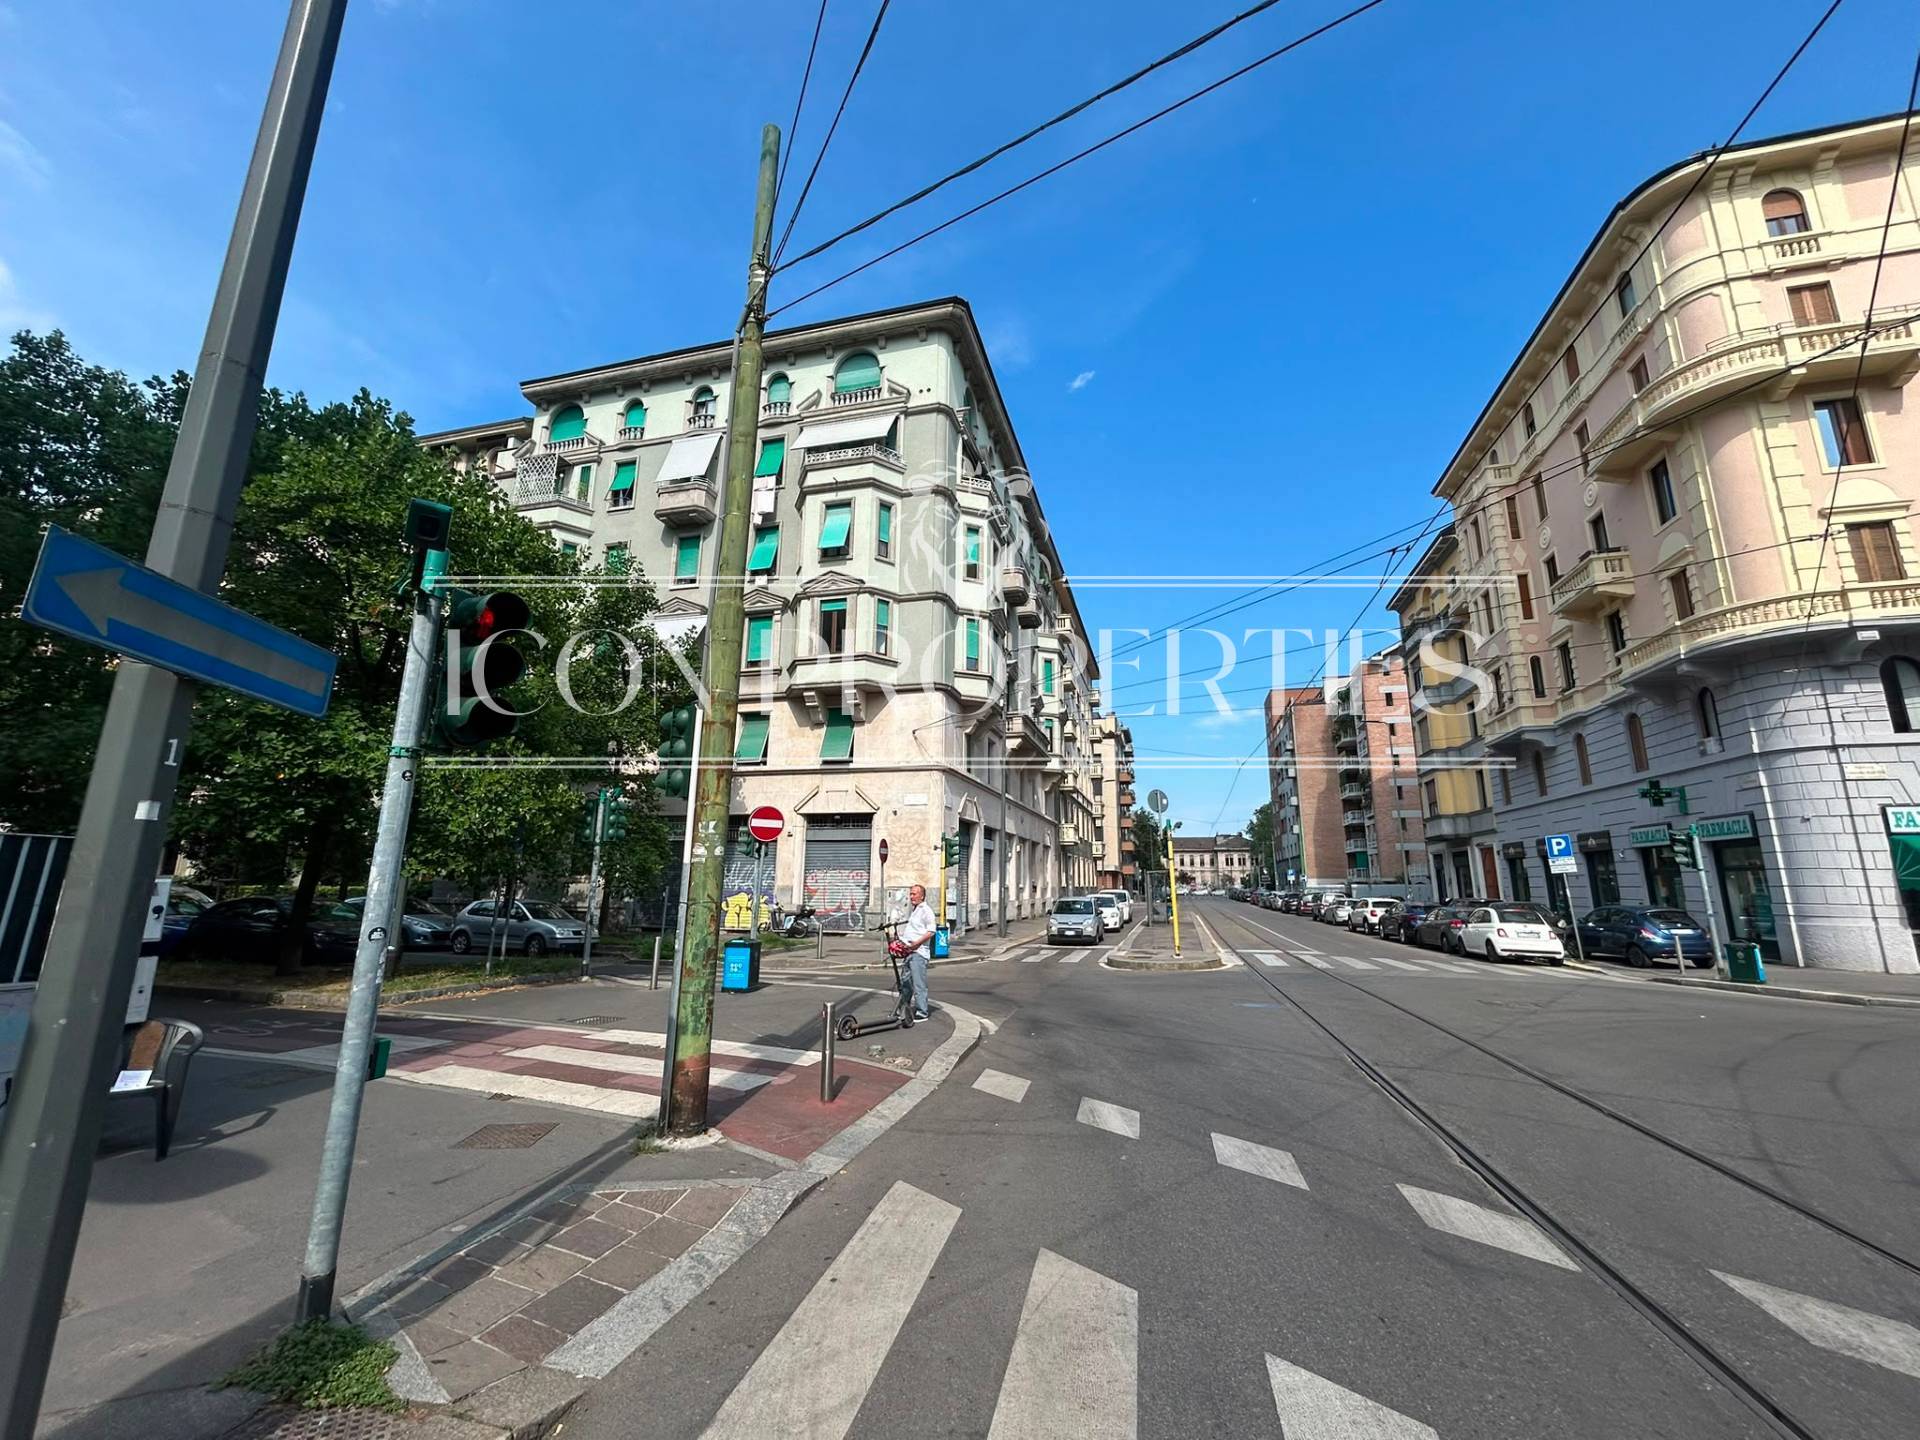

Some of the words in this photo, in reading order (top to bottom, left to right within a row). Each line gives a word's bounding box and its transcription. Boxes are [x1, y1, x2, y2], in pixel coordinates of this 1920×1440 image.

[164, 738, 178, 766] 1
[1697, 818, 1750, 837] FARMACIA
[1891, 811, 1920, 828] FA
[1551, 838, 1566, 855] P
